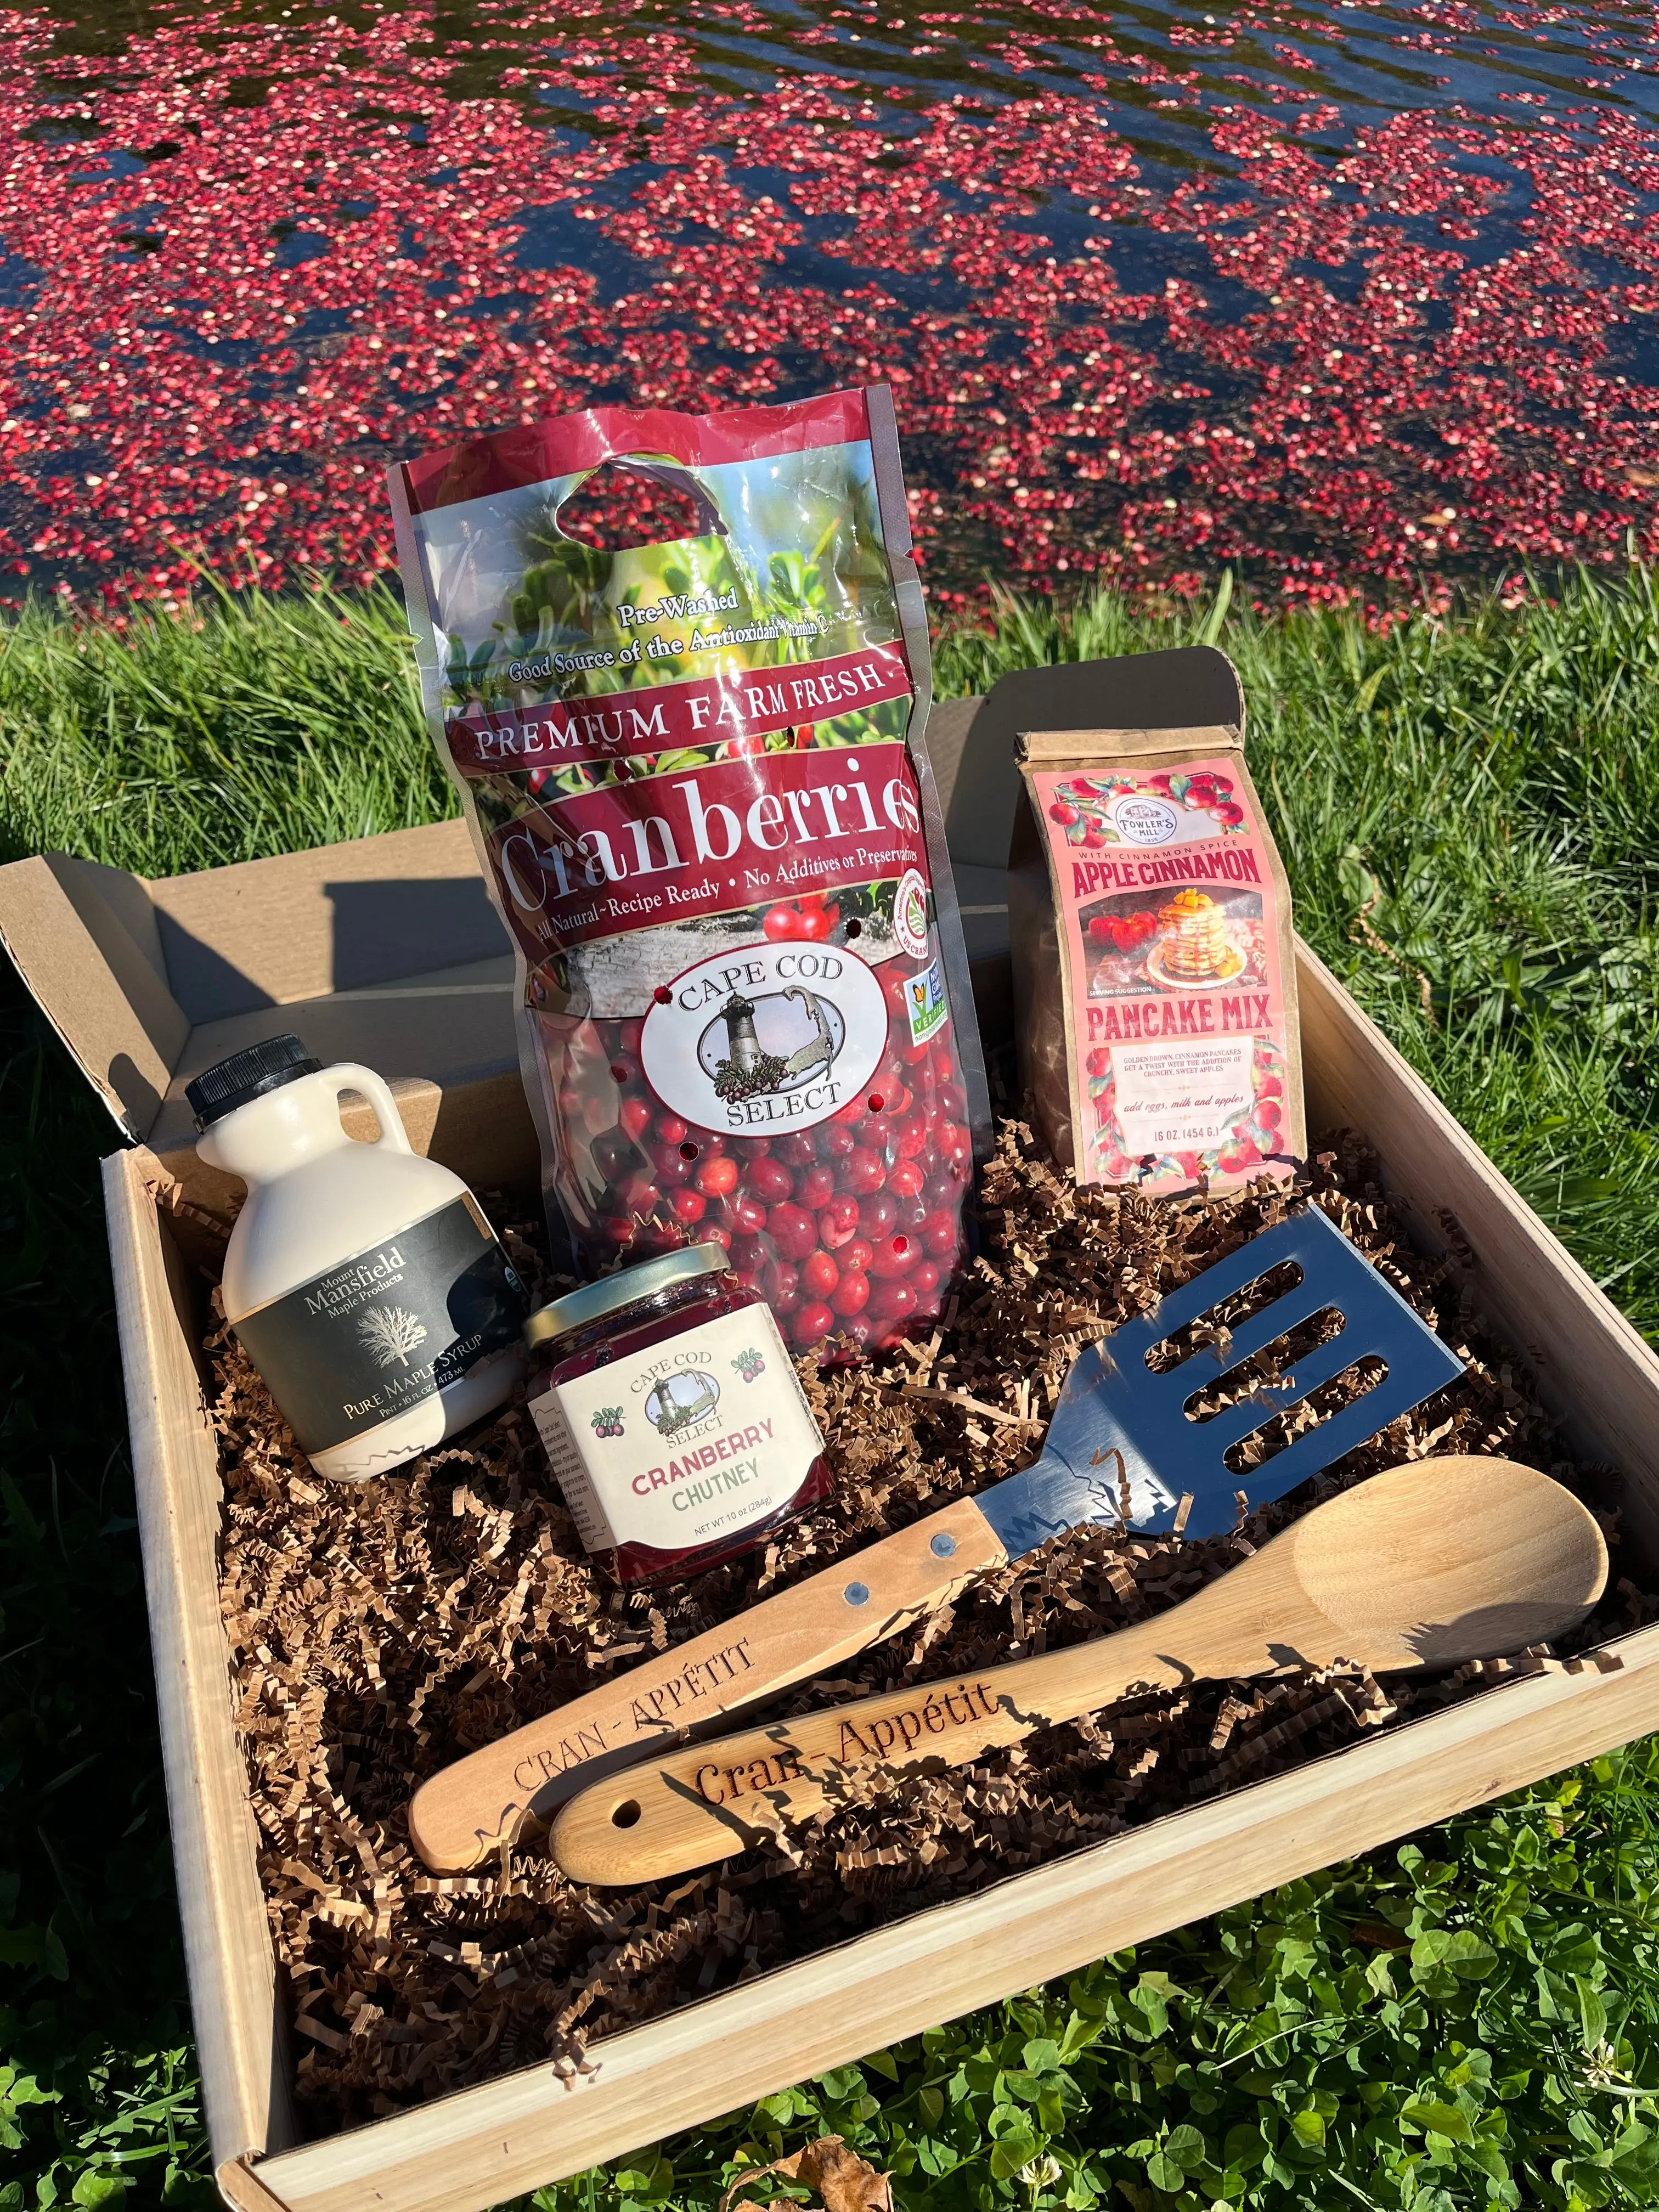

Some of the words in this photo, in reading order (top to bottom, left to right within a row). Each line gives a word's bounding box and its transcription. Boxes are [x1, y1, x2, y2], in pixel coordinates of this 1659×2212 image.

[617, 586, 739, 627] Pre-Washed
[509, 661, 550, 683] Good
[554, 650, 614, 675] Source
[619, 641, 643, 664] of
[647, 638, 684, 659] the
[689, 619, 780, 651] Antioxidant
[474, 703, 670, 760] PREMIUM
[685, 680, 787, 730] FARM
[795, 663, 885, 710] FRESH
[501, 758, 919, 912] Cranberries
[1120, 819, 1173, 831] FOWLER'S
[1119, 847, 1192, 860] CINNAMON
[1200, 839, 1238, 850] SPICE
[1071, 862, 1138, 898] APPLE
[1139, 849, 1262, 885] CINNAMON
[537, 918, 552, 941] All
[665, 879, 720, 904] Ready
[744, 868, 770, 888] No
[776, 856, 840, 882] Additives
[843, 856, 854, 868] or
[678, 962, 765, 1012] CAPE
[775, 954, 843, 980] COD
[916, 1001, 945, 1030] VERIFIED
[1086, 999, 1215, 1041] PANCAKE
[1221, 994, 1273, 1031] MIX
[1175, 1051, 1209, 1059] CINNAMON
[1201, 1057, 1231, 1065] ADDITION
[726, 1082, 840, 1127] SELECT
[1124, 1102, 1142, 1112] add
[1145, 1102, 1168, 1113] eggs,
[1171, 1098, 1192, 1109] milk
[1194, 1096, 1211, 1107] and
[1215, 1094, 1243, 1108] apples
[1155, 1131, 1164, 1141] 16
[1166, 1130, 1181, 1140] OZ.
[1183, 1127, 1204, 1139] (454
[1207, 1126, 1218, 1137] G.)
[304, 1246, 407, 1316] Mansfield
[320, 1268, 356, 1291] Mount
[328, 1299, 359, 1319] Maple
[358, 1273, 404, 1302] Products
[343, 1393, 384, 1420] PURE
[383, 1362, 439, 1399] MAPLE
[438, 1334, 482, 1367] SYRUP
[379, 1404, 398, 1418] PINT
[402, 1395, 411, 1405] 16
[421, 1385, 433, 1395] OZ
[438, 1370, 453, 1384] 473
[630, 1358, 672, 1394] CAPE
[674, 1352, 712, 1367] COD
[666, 1415, 724, 1449] SELECT
[631, 1418, 774, 1496] CRANBERRY
[672, 1457, 759, 1512] CHUTNEY
[694, 1524, 710, 1536] NET
[710, 1517, 725, 1529] WT
[726, 1511, 738, 1522] 10
[738, 1507, 748, 1517] oz
[748, 1496, 772, 1515] (284g)
